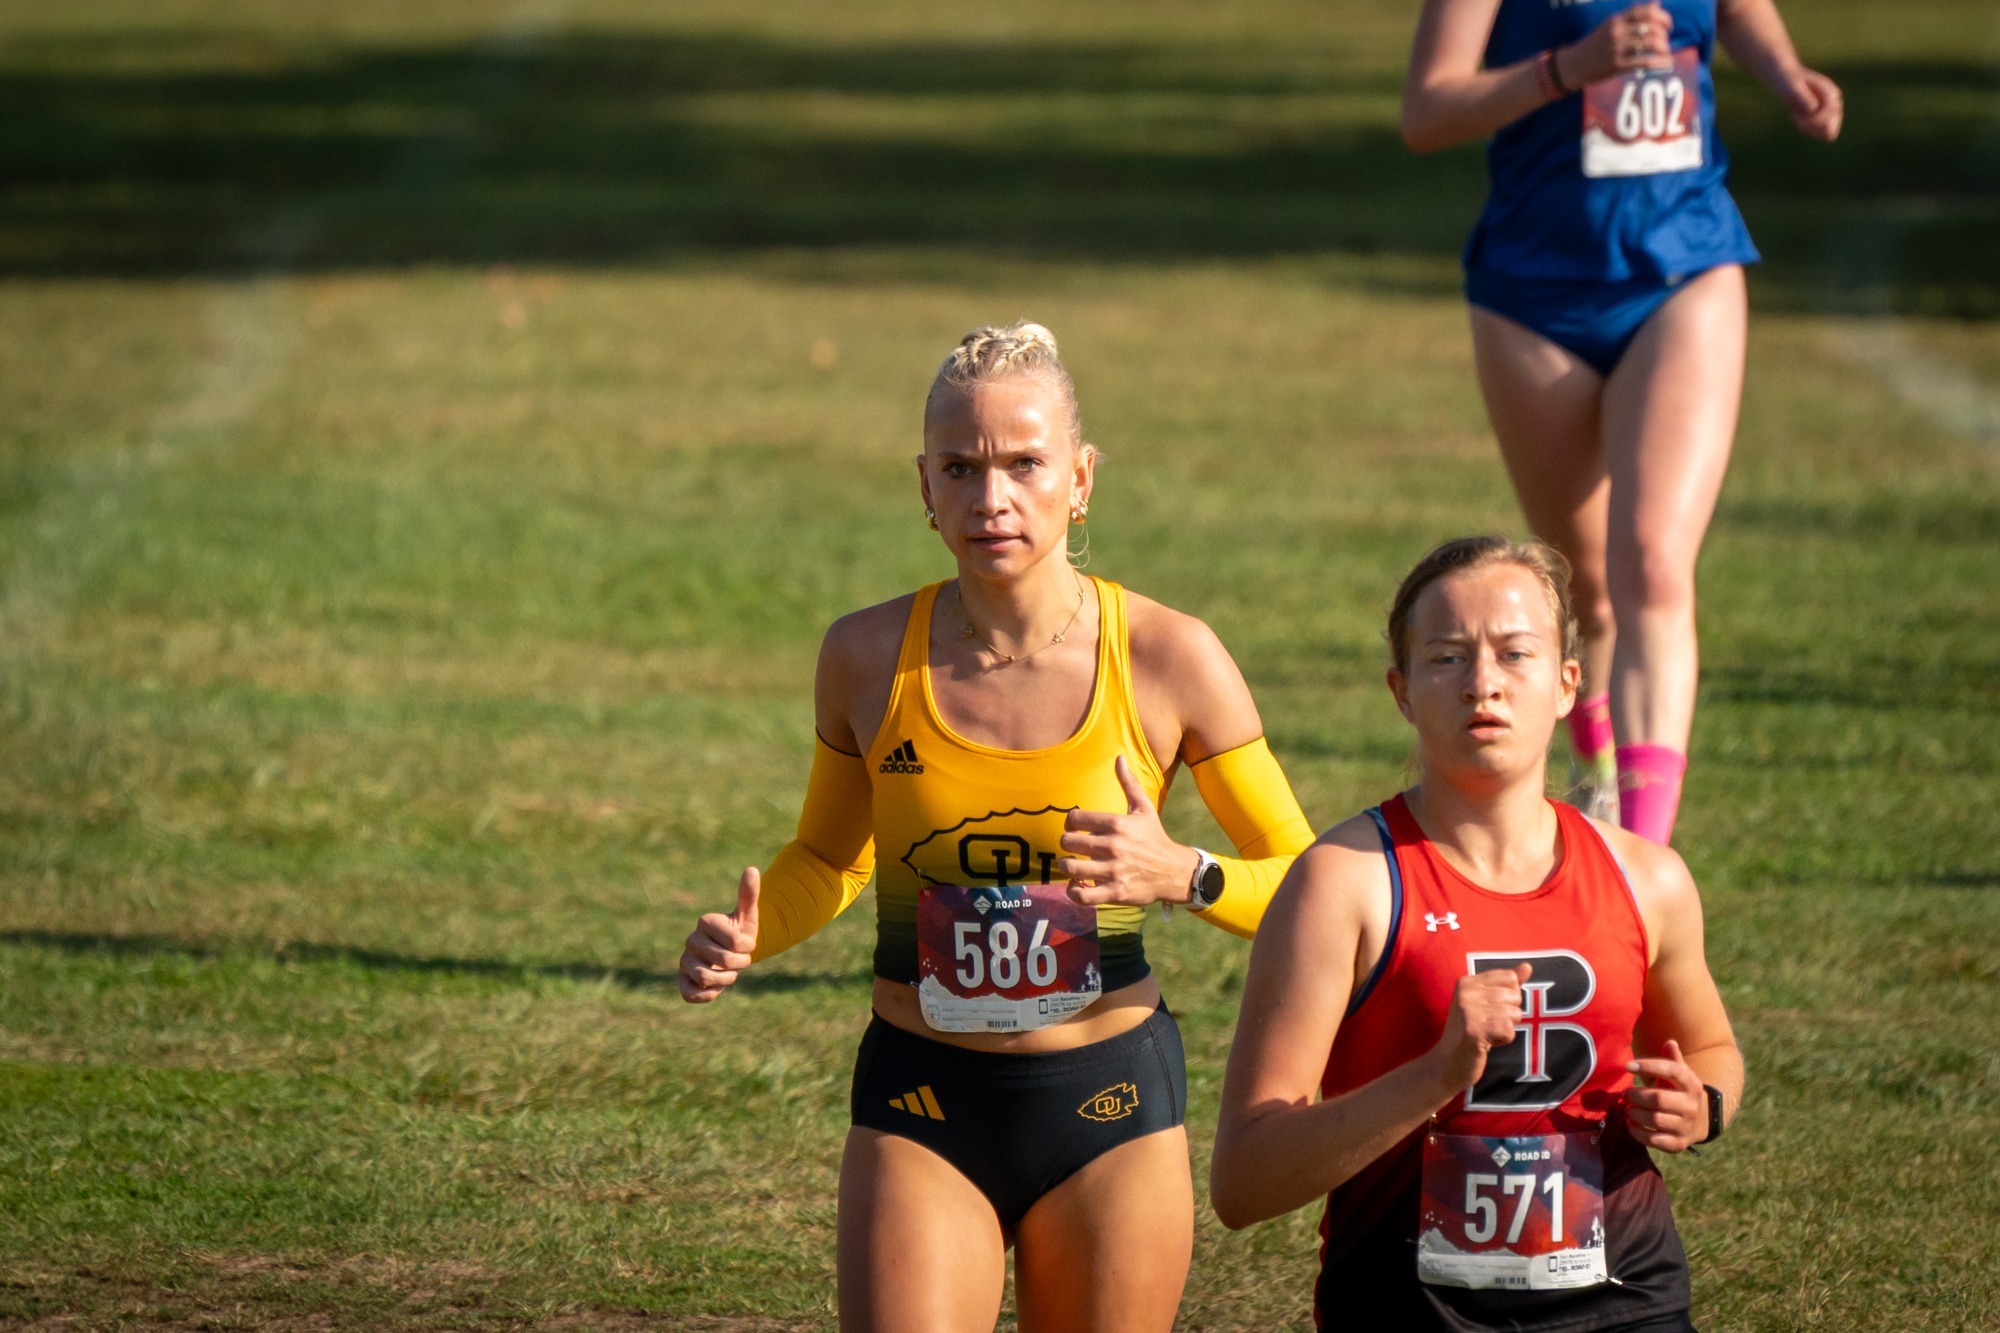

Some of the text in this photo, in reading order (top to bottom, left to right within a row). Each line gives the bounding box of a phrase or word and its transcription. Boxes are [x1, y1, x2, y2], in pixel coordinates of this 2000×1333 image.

[1617, 77, 1685, 140] 602
[879, 761, 924, 775] adidas
[995, 899, 1019, 909] ROAD
[955, 920, 1058, 989] 586
[1465, 949, 1597, 1111] B
[1095, 1096, 1121, 1116] OU
[1514, 1151, 1540, 1161] ROAD
[1464, 1171, 1564, 1244] 571
